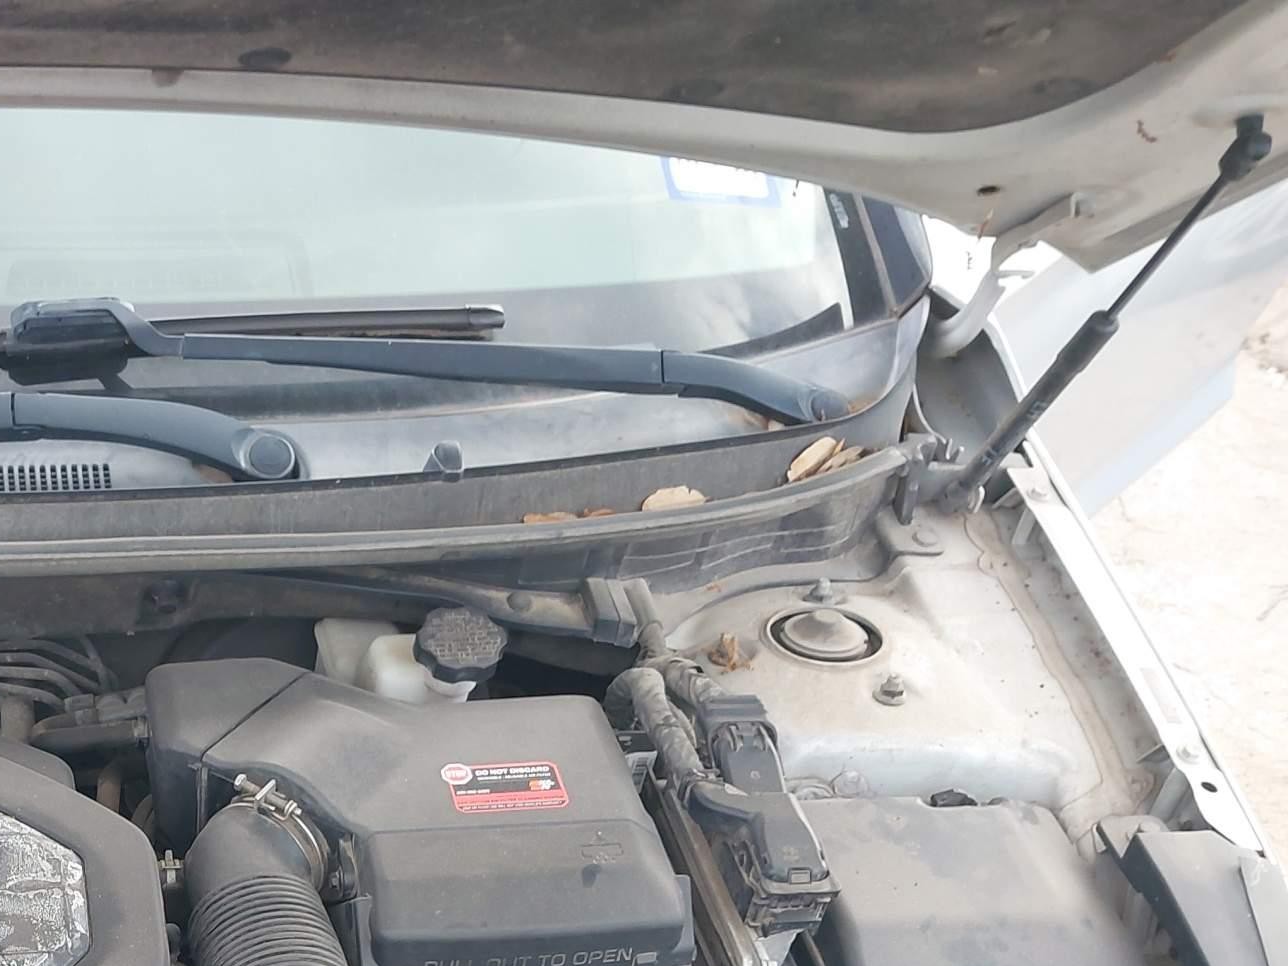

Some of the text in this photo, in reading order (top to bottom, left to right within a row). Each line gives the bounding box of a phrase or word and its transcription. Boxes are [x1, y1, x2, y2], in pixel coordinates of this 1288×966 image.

[475, 769, 489, 777] DO
[490, 768, 508, 776] NOT
[510, 766, 550, 775] DISCARD
[573, 947, 632, 966] OPEN
